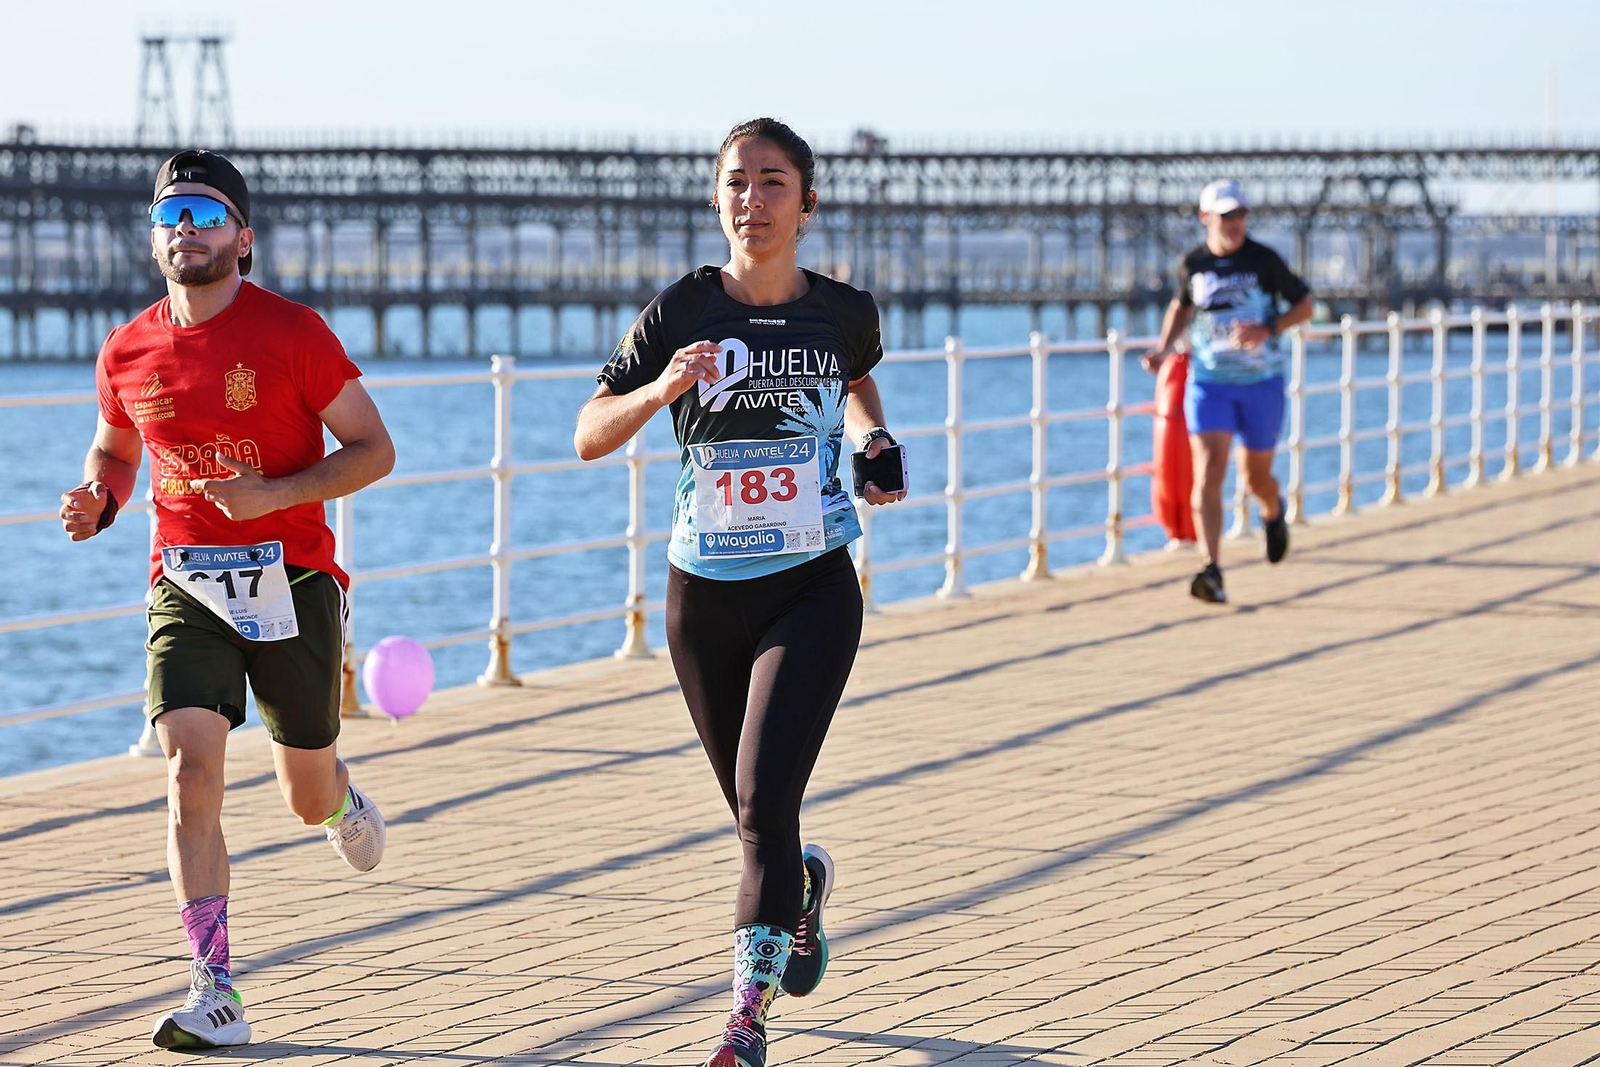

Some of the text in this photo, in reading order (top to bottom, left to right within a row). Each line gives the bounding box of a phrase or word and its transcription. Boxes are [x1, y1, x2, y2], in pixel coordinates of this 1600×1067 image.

[750, 349, 841, 377] HUELVA
[749, 379, 774, 389] PUERTA
[776, 378, 788, 388] DEL
[134, 397, 174, 410] Espanicar
[735, 391, 811, 410] AVATEL
[158, 433, 261, 477] ESPAÑA
[716, 448, 740, 459] HUELVA
[743, 446, 784, 459] AVATEL
[716, 467, 798, 507] 183
[754, 521, 787, 530] GABARDINO
[717, 531, 776, 548] Wayalia
[213, 551, 251, 562] AVATEL
